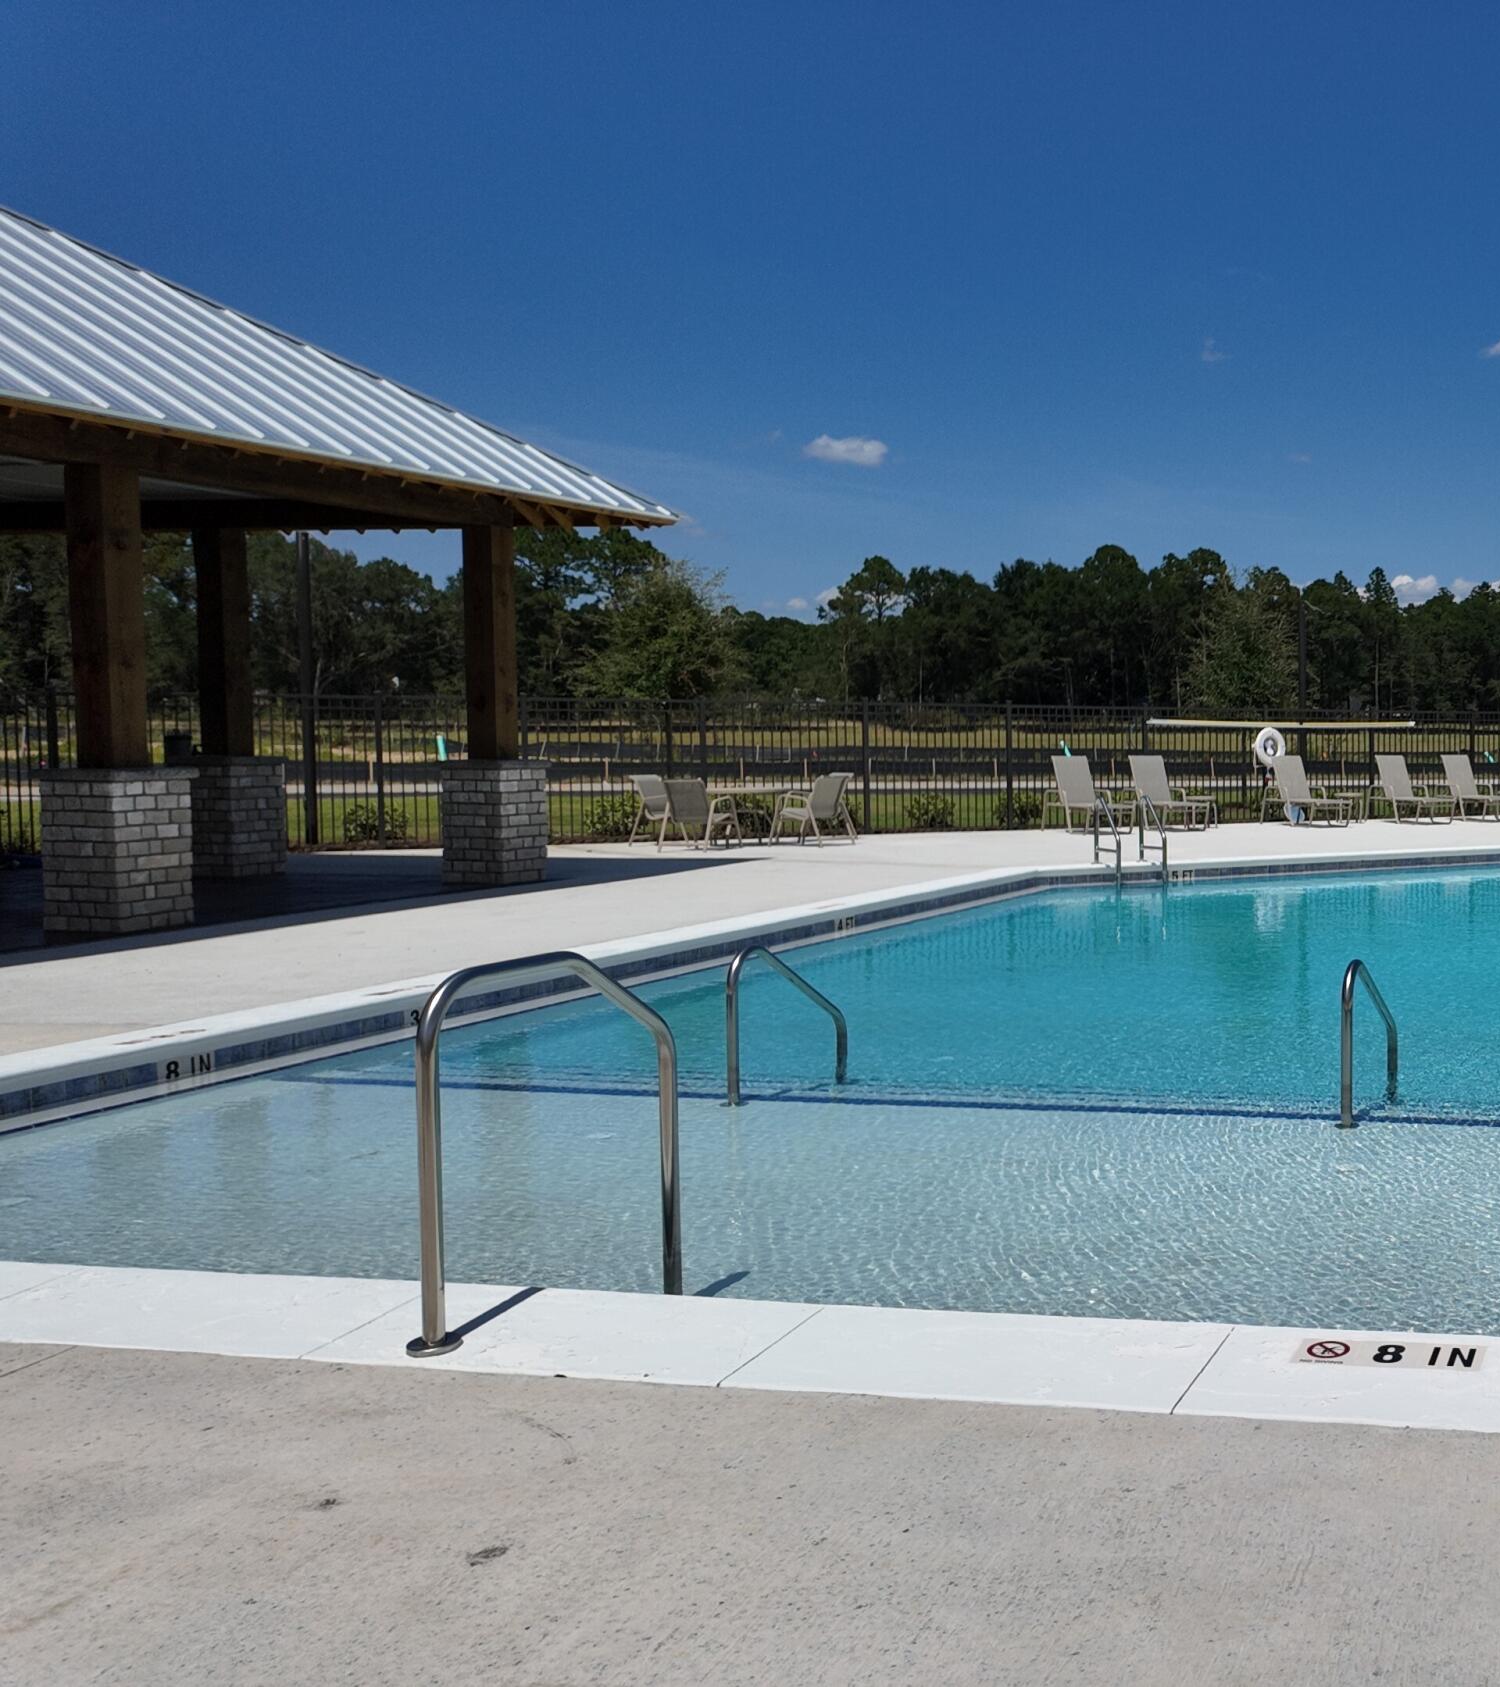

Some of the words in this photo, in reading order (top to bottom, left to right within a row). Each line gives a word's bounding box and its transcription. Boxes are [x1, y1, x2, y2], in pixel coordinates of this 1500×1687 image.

[1172, 870, 1178, 880] 5
[1182, 869, 1193, 880] FT
[838, 919, 843, 930] 4
[846, 916, 854, 928] FT
[410, 1009, 419, 1026] 3
[166, 1060, 180, 1080] 8
[191, 1052, 212, 1074] IN
[1372, 1344, 1406, 1364] 8
[1428, 1346, 1478, 1368] IN
